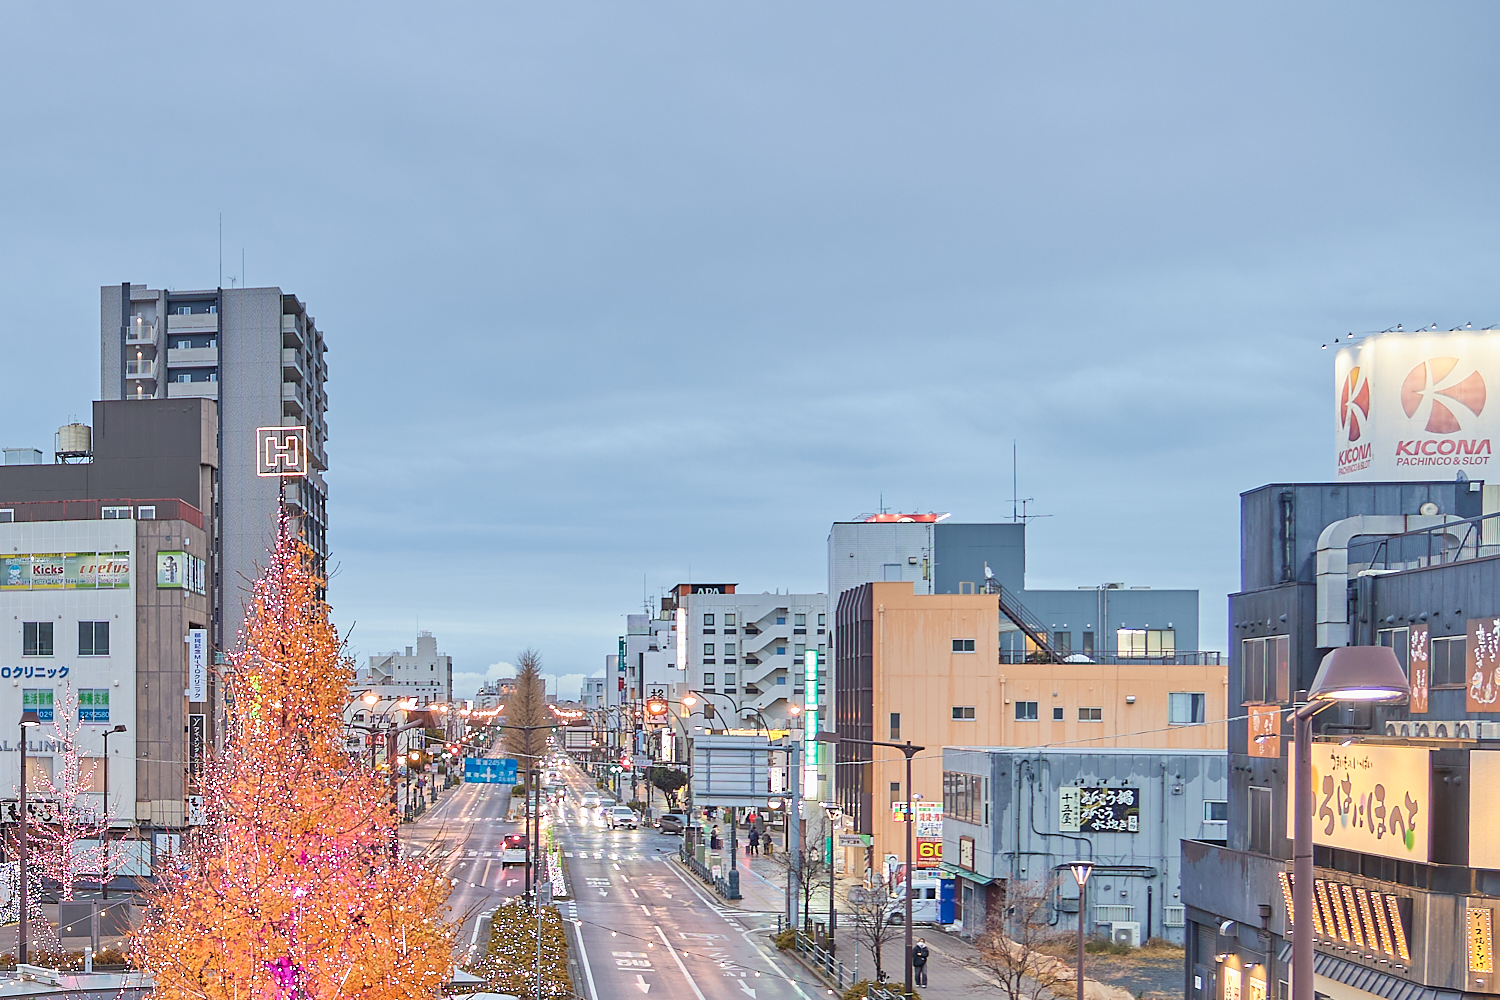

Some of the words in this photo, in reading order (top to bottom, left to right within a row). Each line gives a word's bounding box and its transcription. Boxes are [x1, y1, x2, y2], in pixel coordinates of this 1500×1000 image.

[1338, 442, 1372, 467] KICONA
[1396, 438, 1492, 456] KICONA
[1396, 456, 1451, 466] PACHINCO
[1452, 457, 1461, 466] &
[1462, 456, 1490, 465] SLOT
[33, 564, 64, 575] Kicks
[39, 711, 53, 719] 029
[1080, 789, 1134, 806] あんこう鍋
[1080, 805, 1114, 820] あんこう
